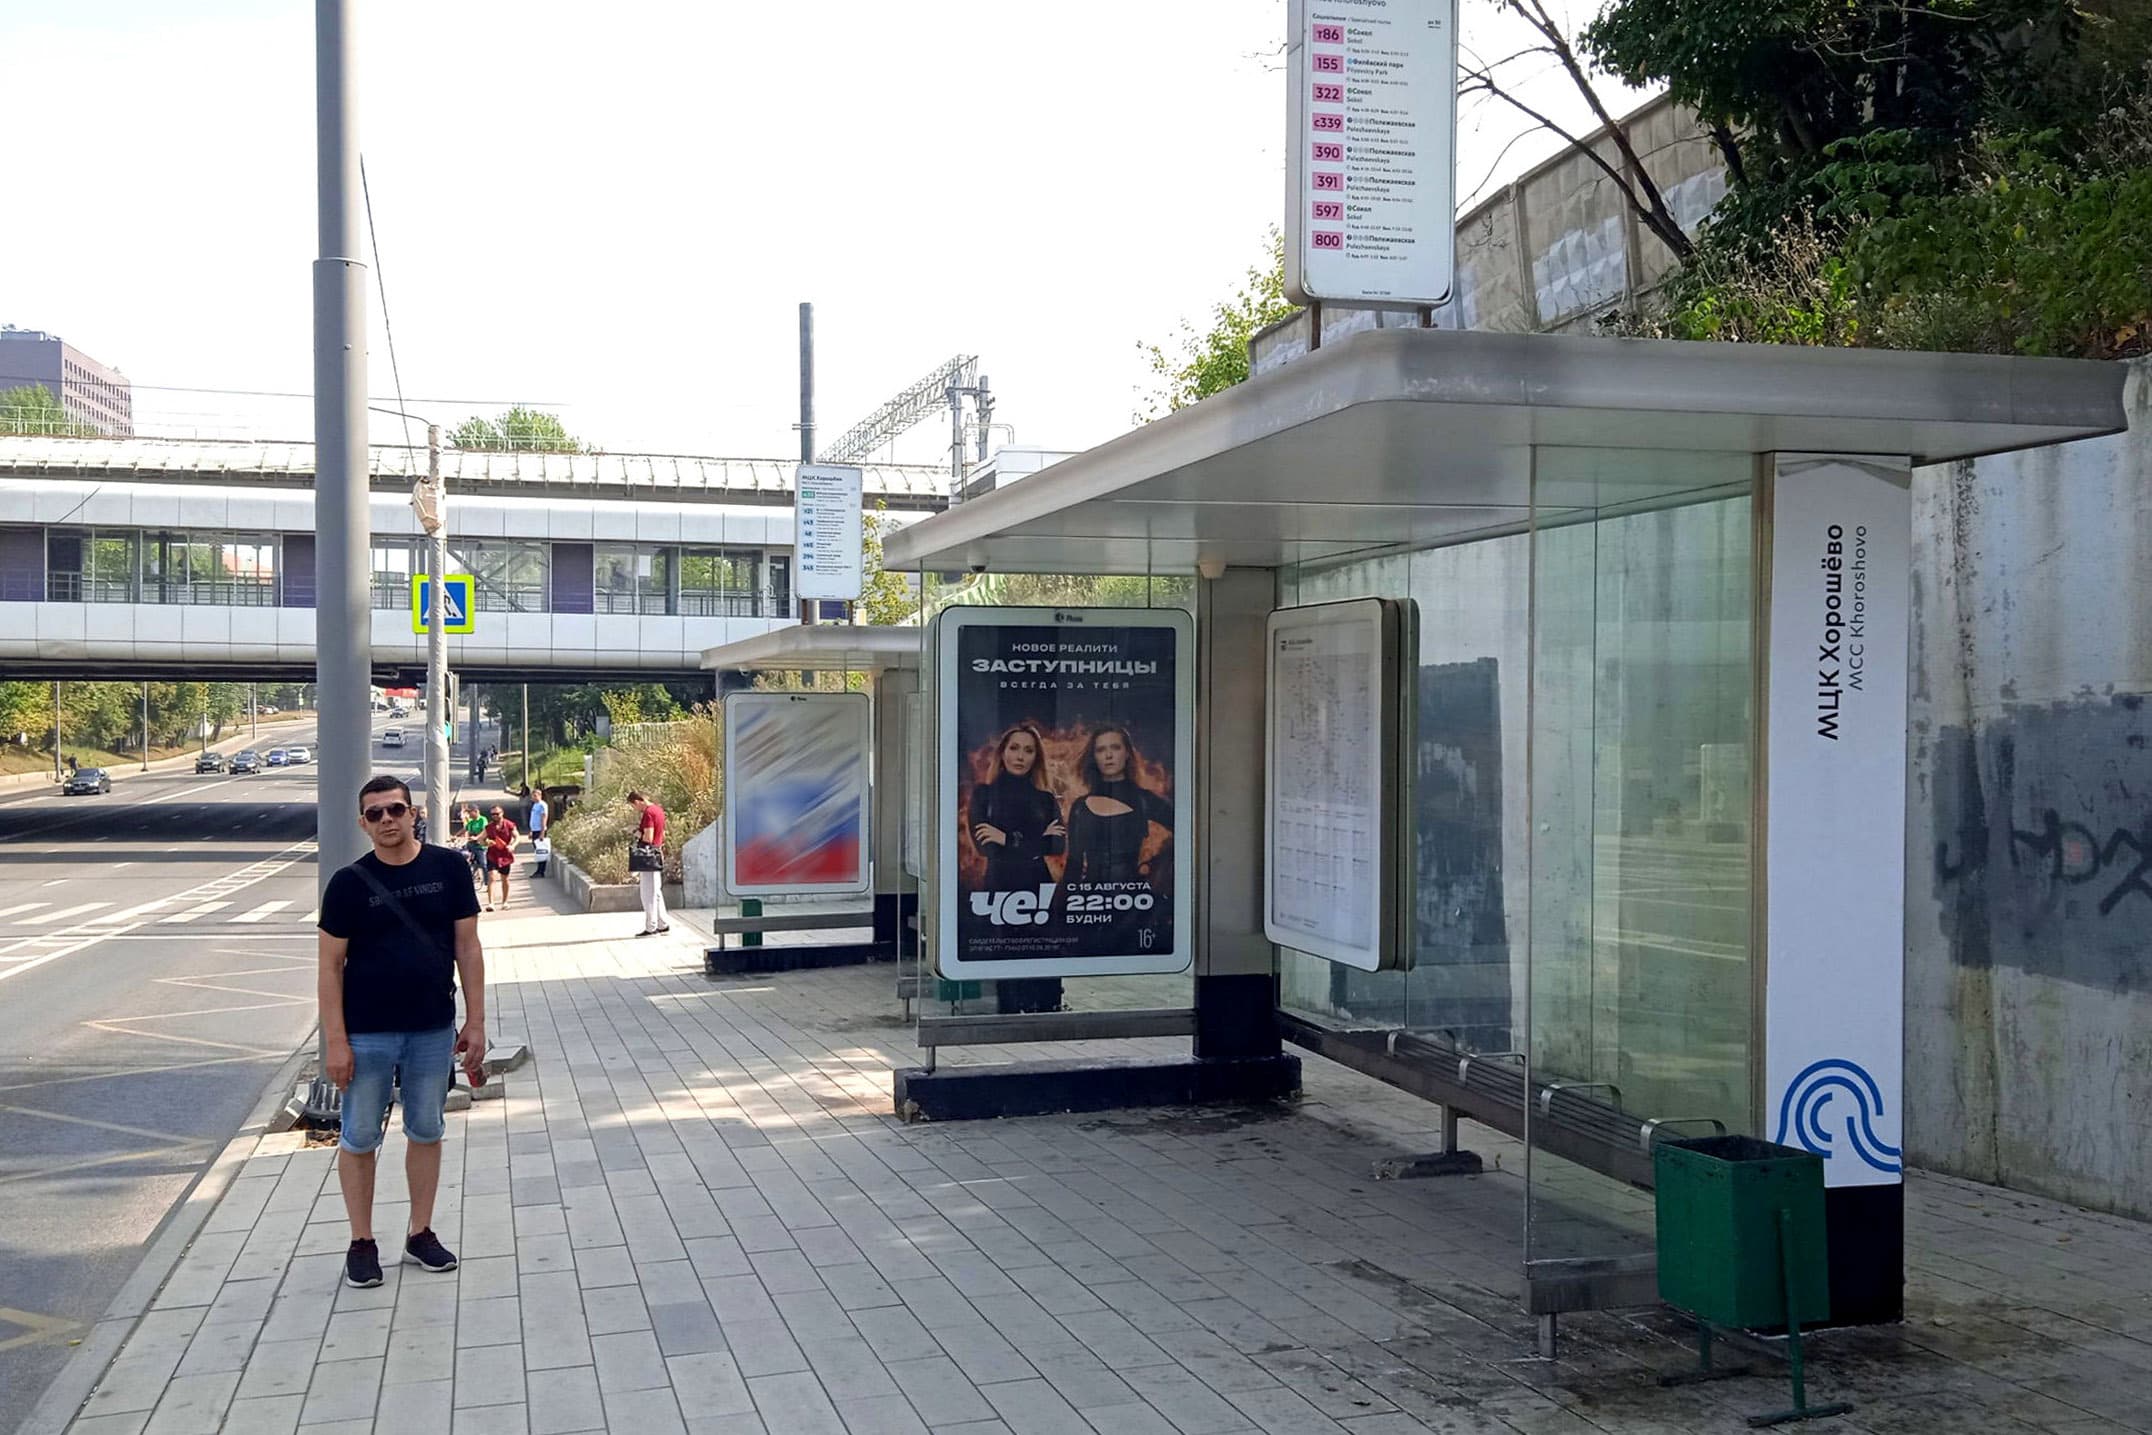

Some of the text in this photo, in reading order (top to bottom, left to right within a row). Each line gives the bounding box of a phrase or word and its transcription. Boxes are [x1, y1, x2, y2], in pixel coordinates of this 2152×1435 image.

[1317, 28, 1339, 41] т86
[1317, 57, 1338, 70] 155
[1316, 87, 1340, 100] 322
[1314, 118, 1341, 129] с339
[1316, 146, 1340, 159] 390
[1317, 176, 1338, 188] 391
[1316, 205, 1339, 217] 597
[1315, 234, 1340, 247] 800
[1849, 525, 1867, 691] MCC Khoroshovo
[1818, 524, 1846, 740] МЦК Хорошёво
[1012, 643, 1118, 653] НОВОЕ РЕАЛИТИ
[972, 659, 1157, 676] ЗАСТУПНИЦЫ
[1000, 681, 1058, 689] ВСЕГДА
[1067, 681, 1084, 689] ЗА
[1067, 882, 1151, 891] С 15 АВГУСТА
[1066, 893, 1154, 912] 22:00
[1066, 914, 1112, 924] БУДНИ
